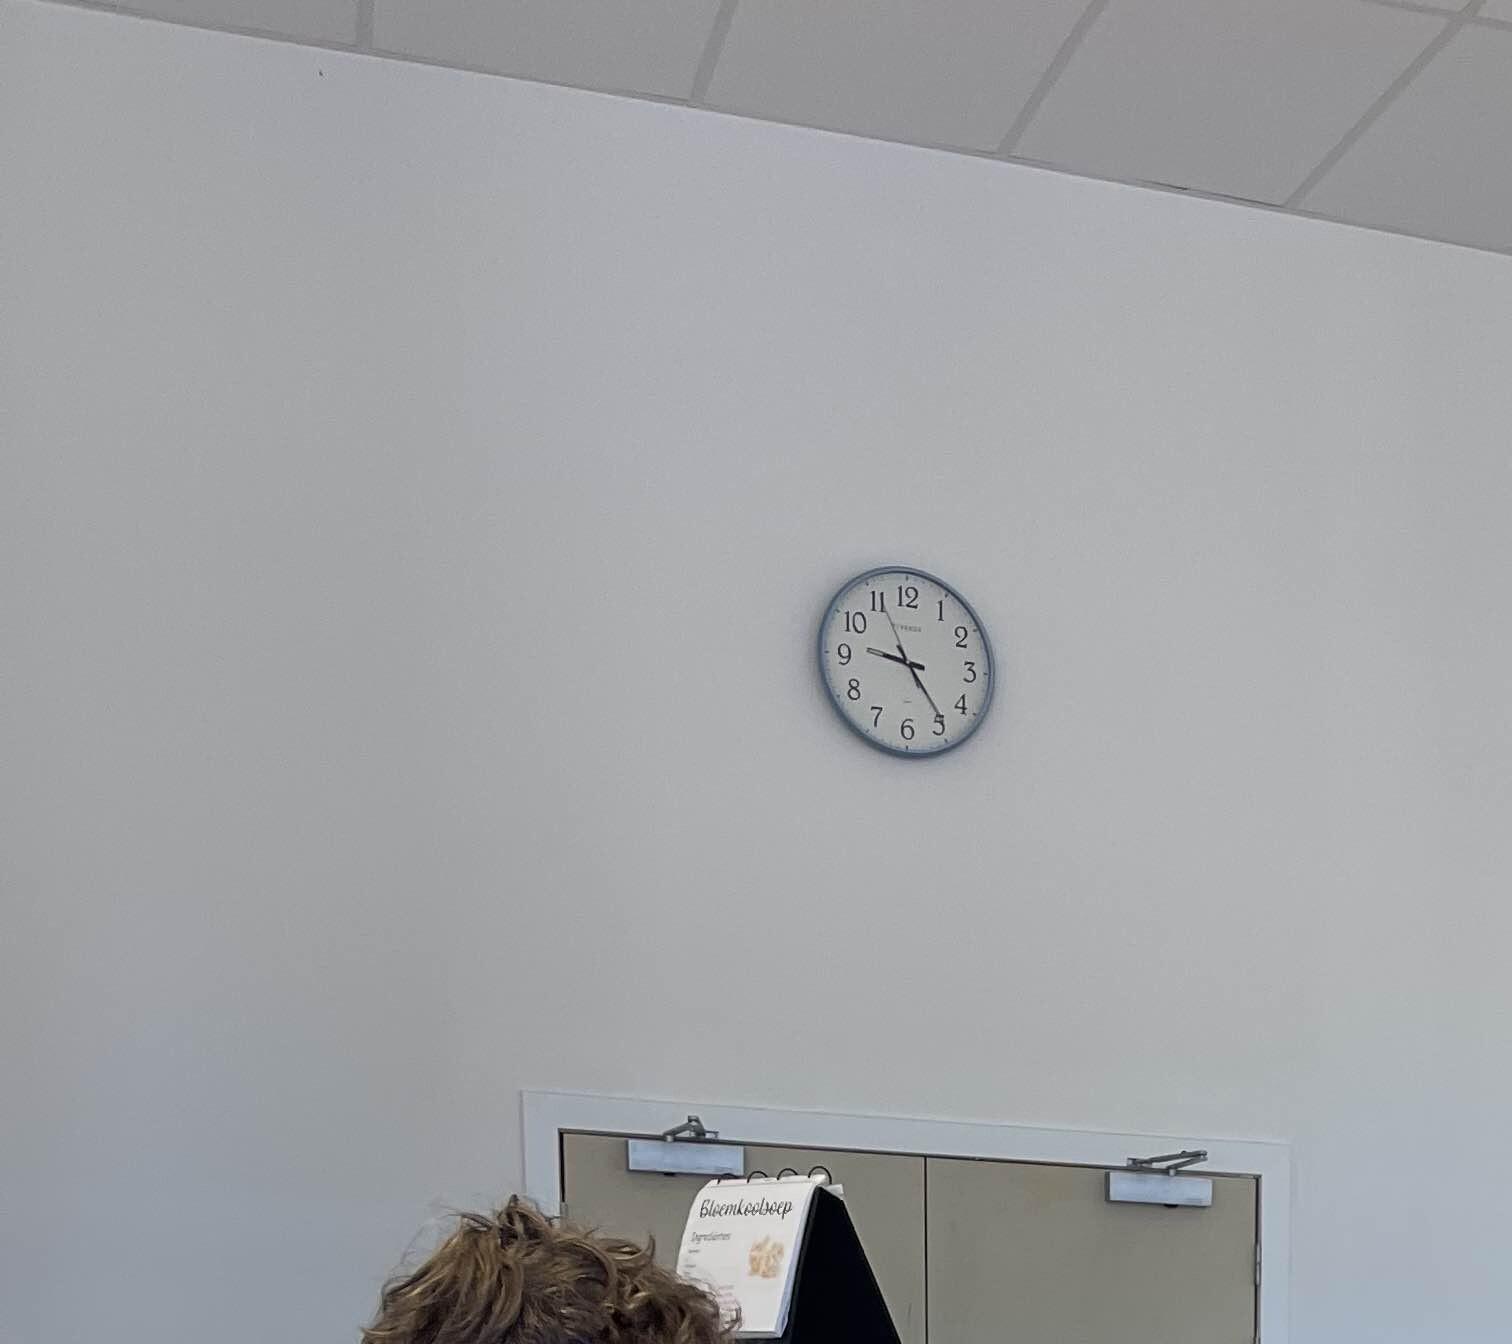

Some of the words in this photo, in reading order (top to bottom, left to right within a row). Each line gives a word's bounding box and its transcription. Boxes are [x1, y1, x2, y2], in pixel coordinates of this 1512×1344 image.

[870, 590, 886, 613] 11
[897, 585, 919, 609] 12
[844, 611, 867, 634] 10
[937, 600, 945, 622] 1
[954, 626, 968, 649] 2
[837, 643, 852, 666] 9
[963, 661, 977, 684] 3
[847, 678, 861, 701] 8
[954, 694, 968, 715] 4
[870, 706, 883, 728] 7
[932, 714, 946, 736] 5
[900, 718, 915, 740] 6
[699, 1197, 793, 1220] Bloemkoolsoep
